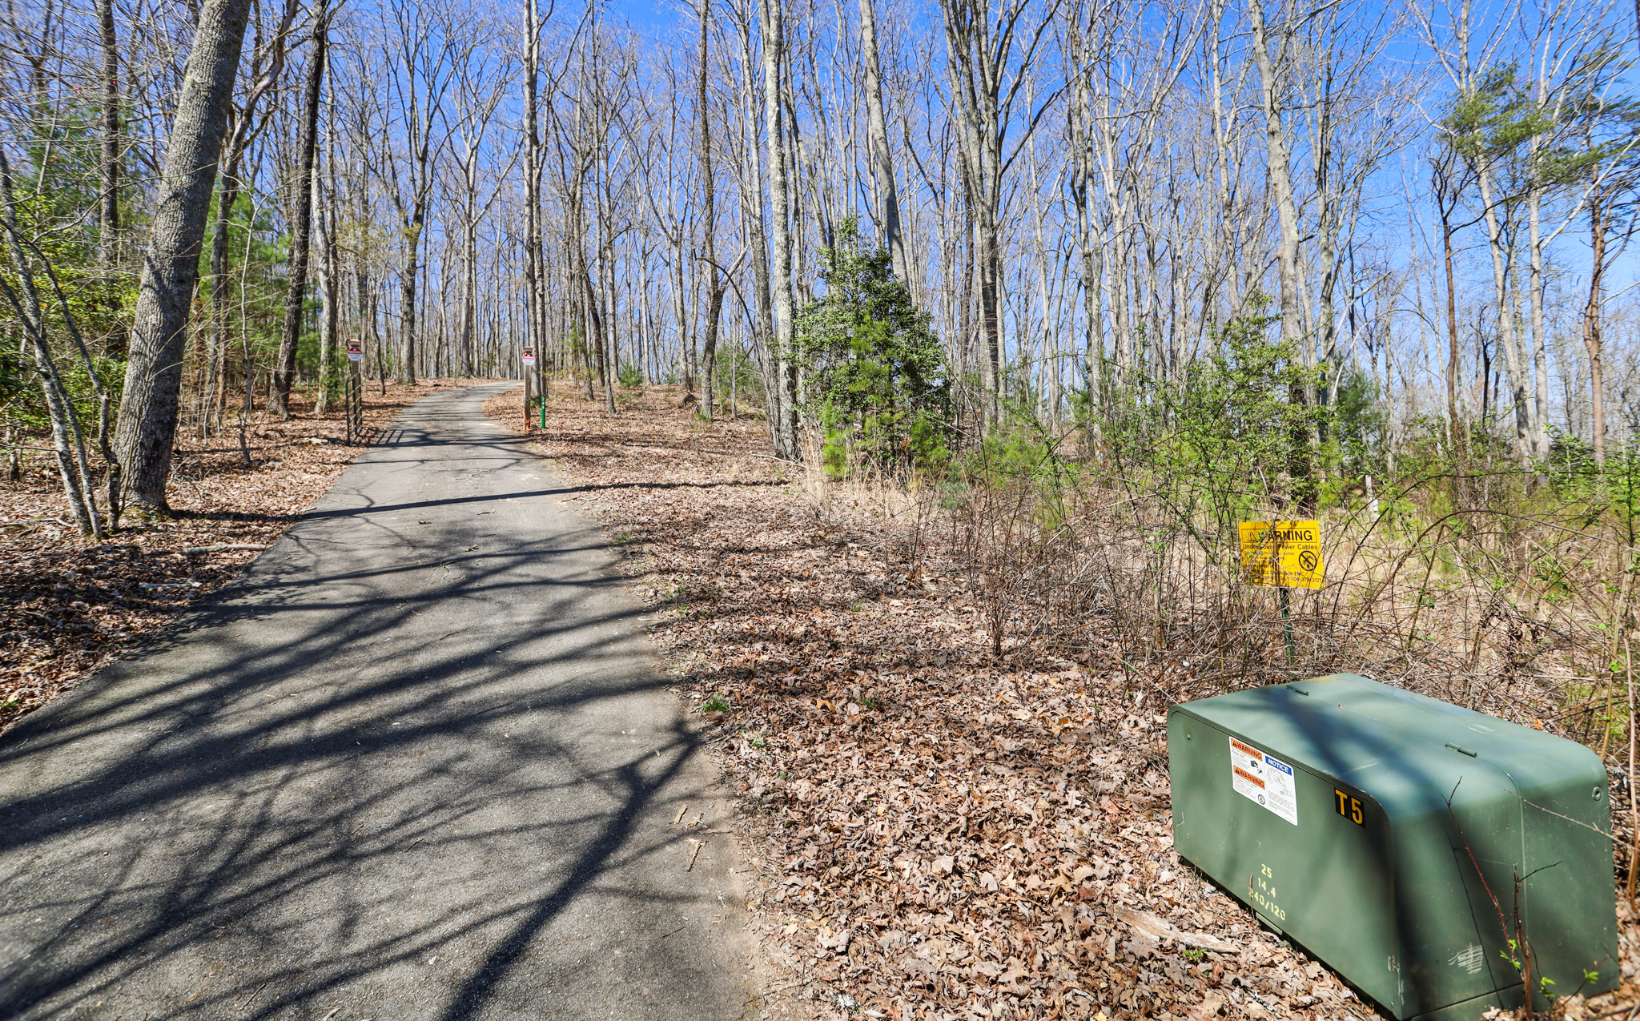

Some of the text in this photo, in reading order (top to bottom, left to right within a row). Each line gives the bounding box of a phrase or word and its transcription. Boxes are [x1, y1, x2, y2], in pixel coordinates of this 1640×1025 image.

[1258, 530, 1313, 542] ARNING
[1267, 758, 1289, 774] NOTICE
[1260, 863, 1272, 878] 25
[1257, 877, 1276, 898] 14.4
